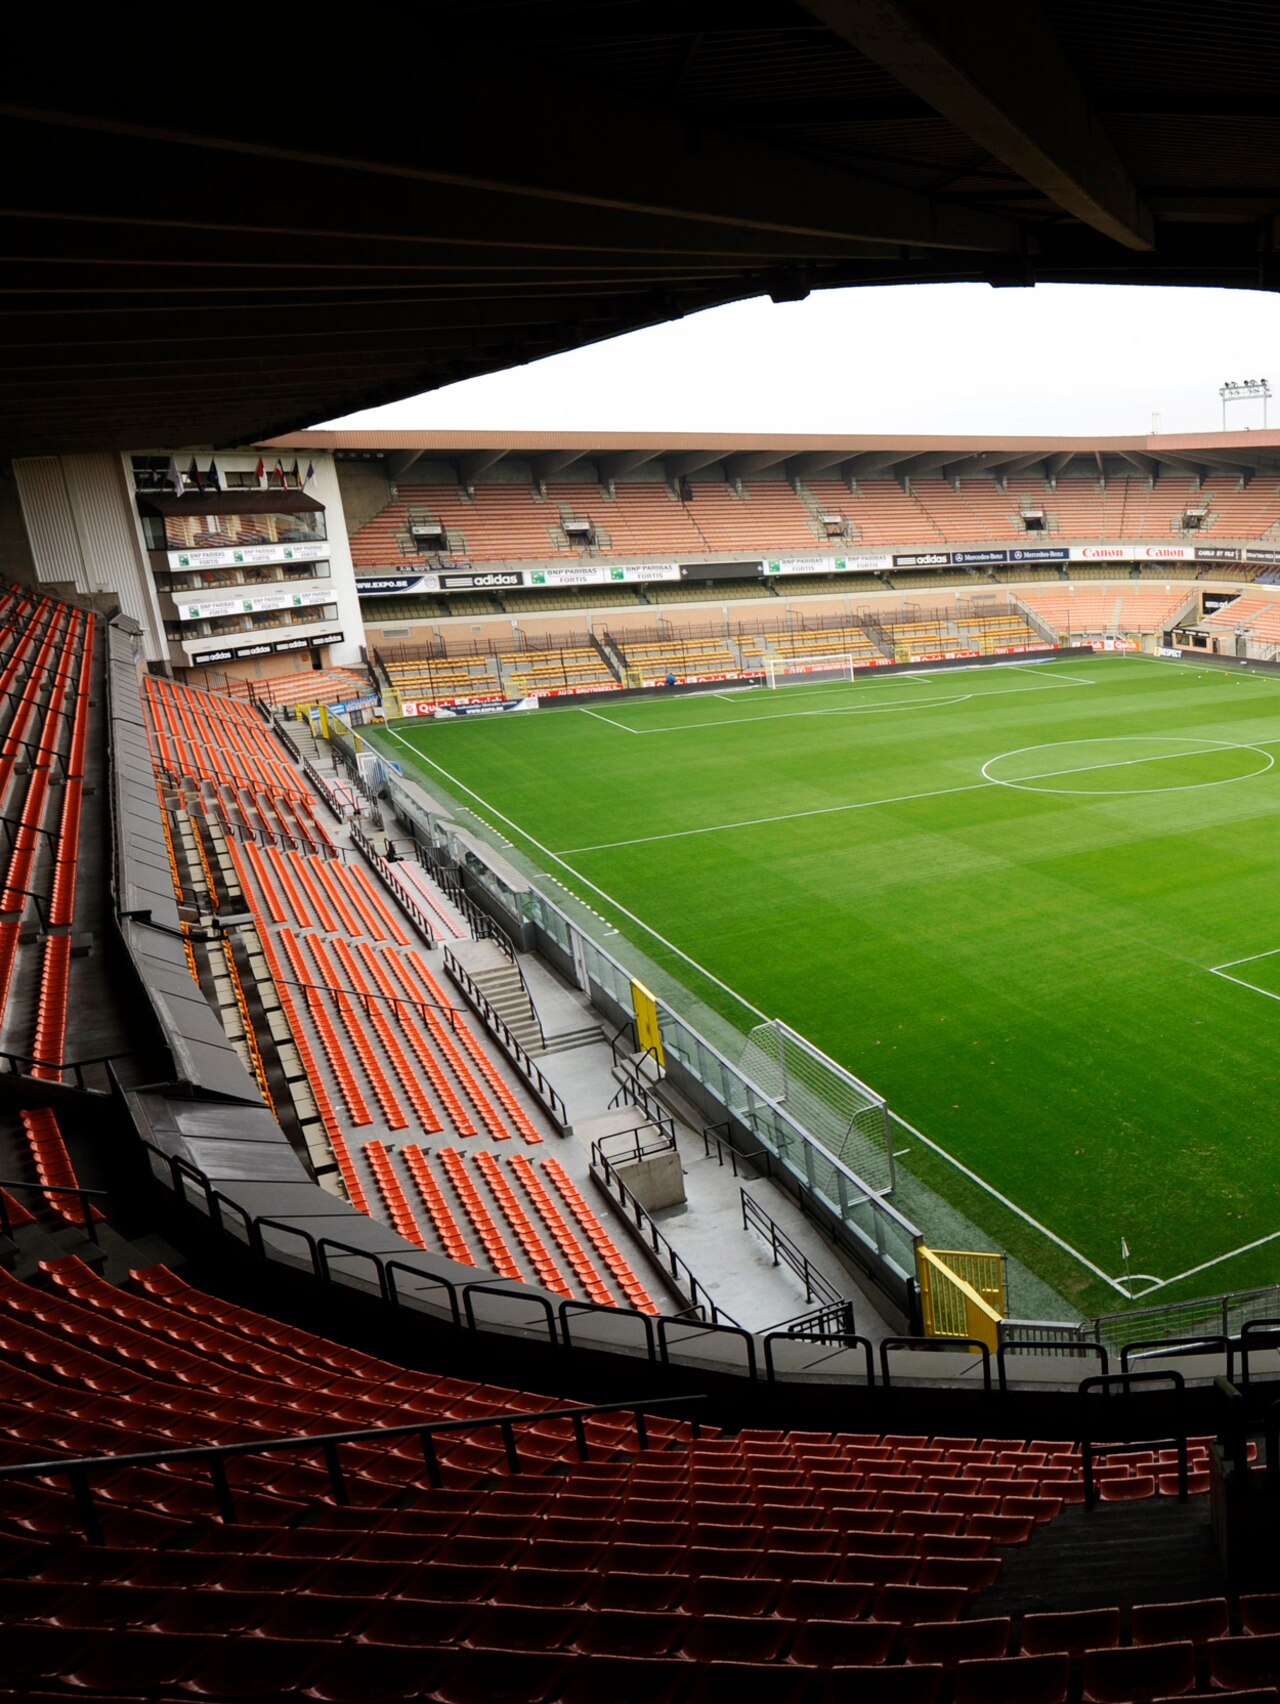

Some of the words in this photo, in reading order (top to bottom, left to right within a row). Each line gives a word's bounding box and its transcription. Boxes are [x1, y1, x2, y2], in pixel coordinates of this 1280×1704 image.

[964, 552, 1004, 562] Mercedes-Benz
[1023, 550, 1064, 560] Mercedes-Benz
[1082, 547, 1123, 558] Canon
[1146, 547, 1185, 558] Canon
[917, 554, 947, 564] adidas
[565, 567, 597, 575] PARIBAS
[642, 564, 673, 572] PARIBAS
[474, 574, 518, 587] adidas
[288, 640, 308, 649] adidas
[324, 635, 342, 645] adidas
[1114, 640, 1137, 649] Quick
[250, 646, 271, 655] adidas
[210, 652, 231, 661] adidas
